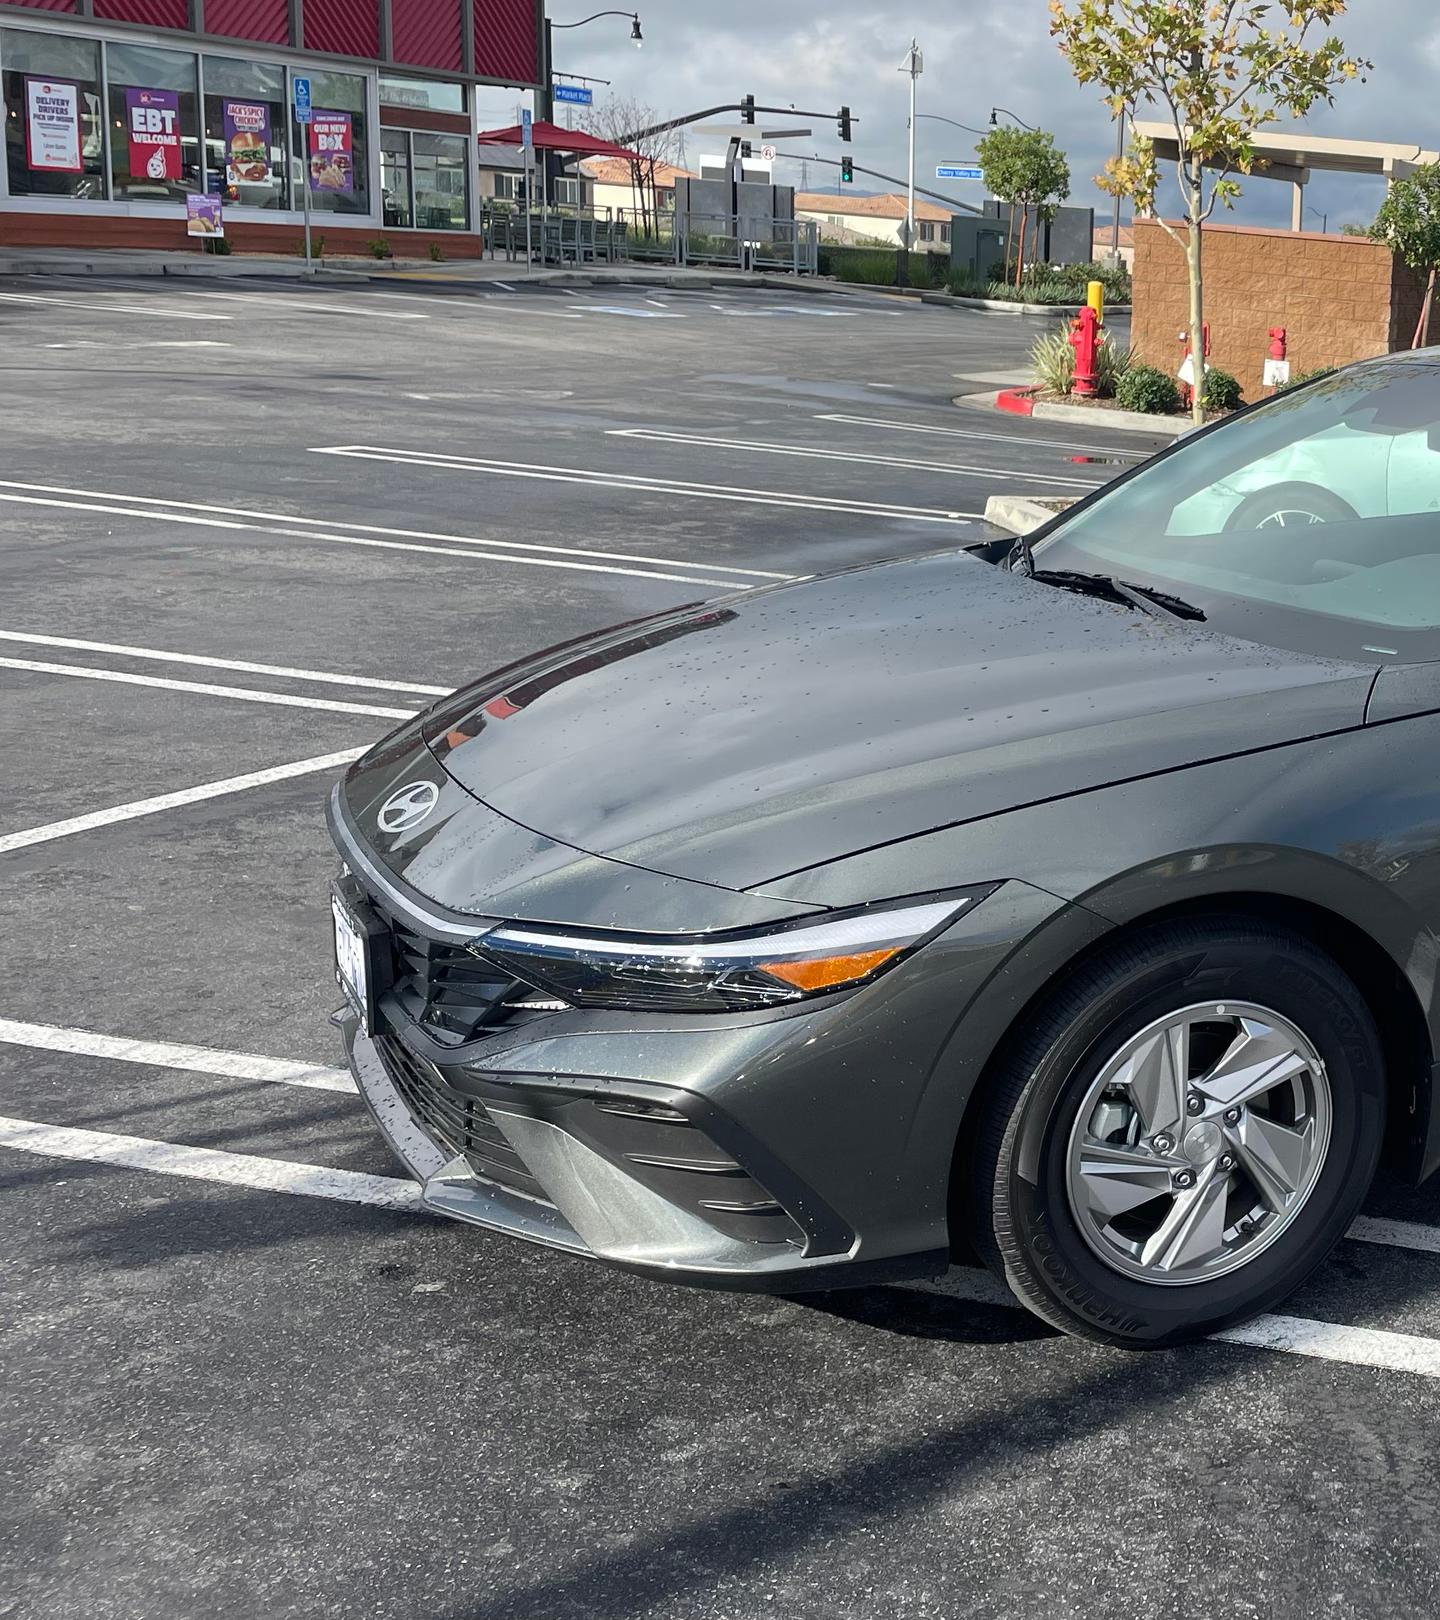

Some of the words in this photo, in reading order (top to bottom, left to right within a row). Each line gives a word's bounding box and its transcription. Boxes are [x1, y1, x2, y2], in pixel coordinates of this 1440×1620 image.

[35, 96, 70, 107] DELIVERY
[38, 105, 69, 115] DRIVERS
[33, 113, 46, 121] PICK
[131, 107, 176, 134] EBT
[235, 116, 257, 125] CHICKEN
[313, 124, 329, 133] OUR
[330, 124, 347, 133] NEW
[132, 133, 177, 145] WELCOME
